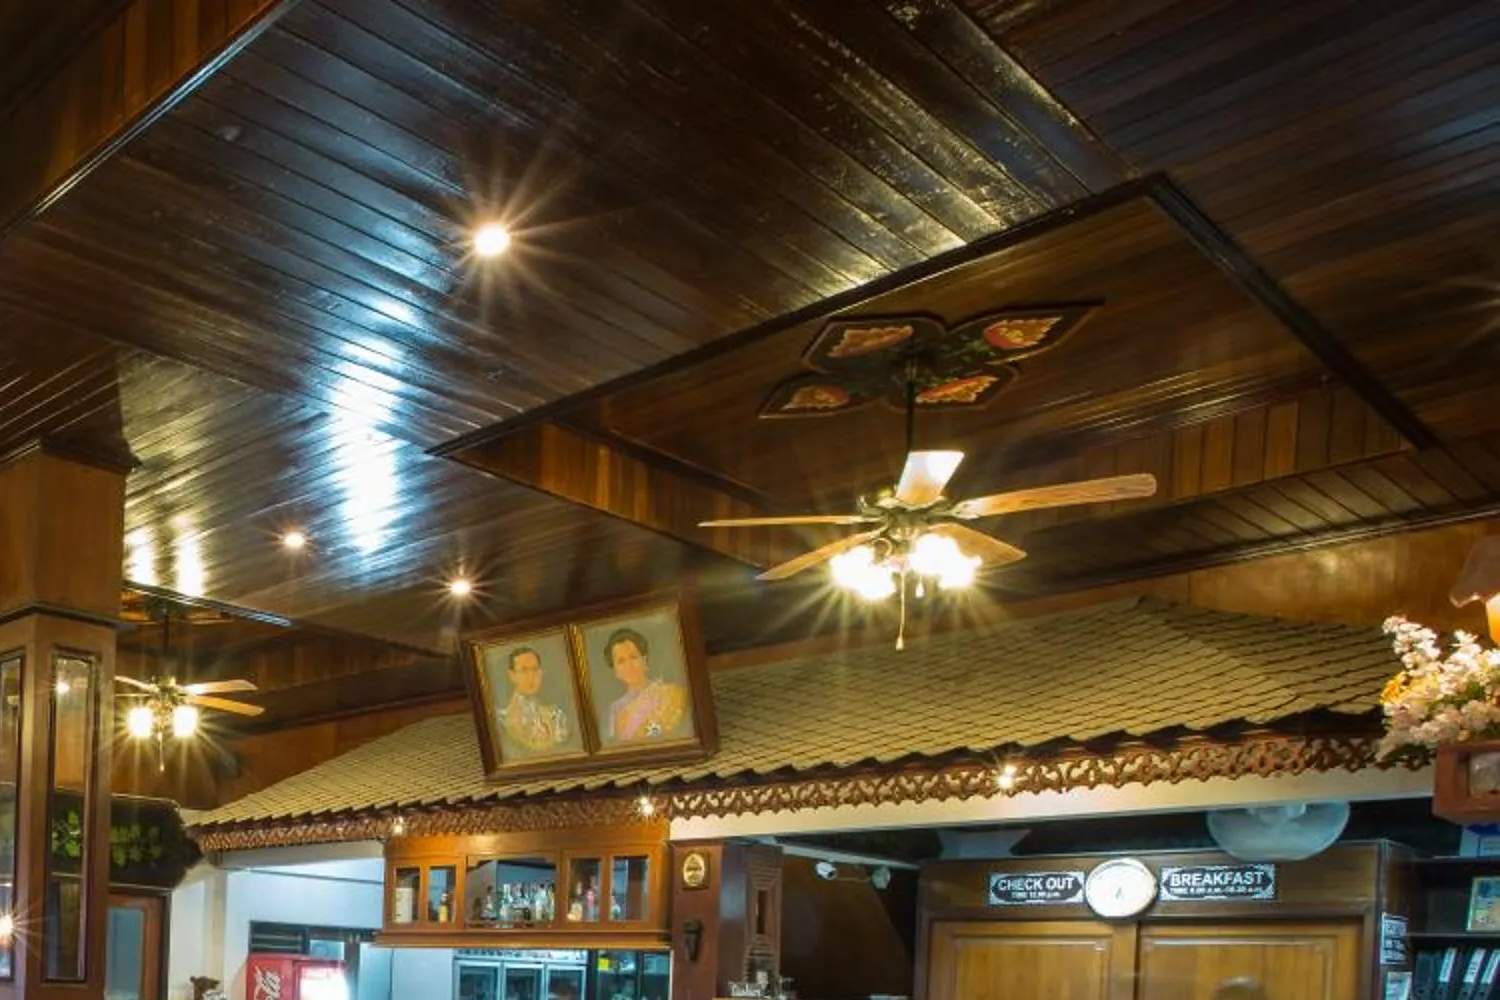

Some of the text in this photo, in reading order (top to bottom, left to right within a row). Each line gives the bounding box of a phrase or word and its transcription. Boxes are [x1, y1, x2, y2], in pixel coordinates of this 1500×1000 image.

[998, 877, 1074, 891] CHECK OUT
[1170, 871, 1264, 887] BREAKFAST
